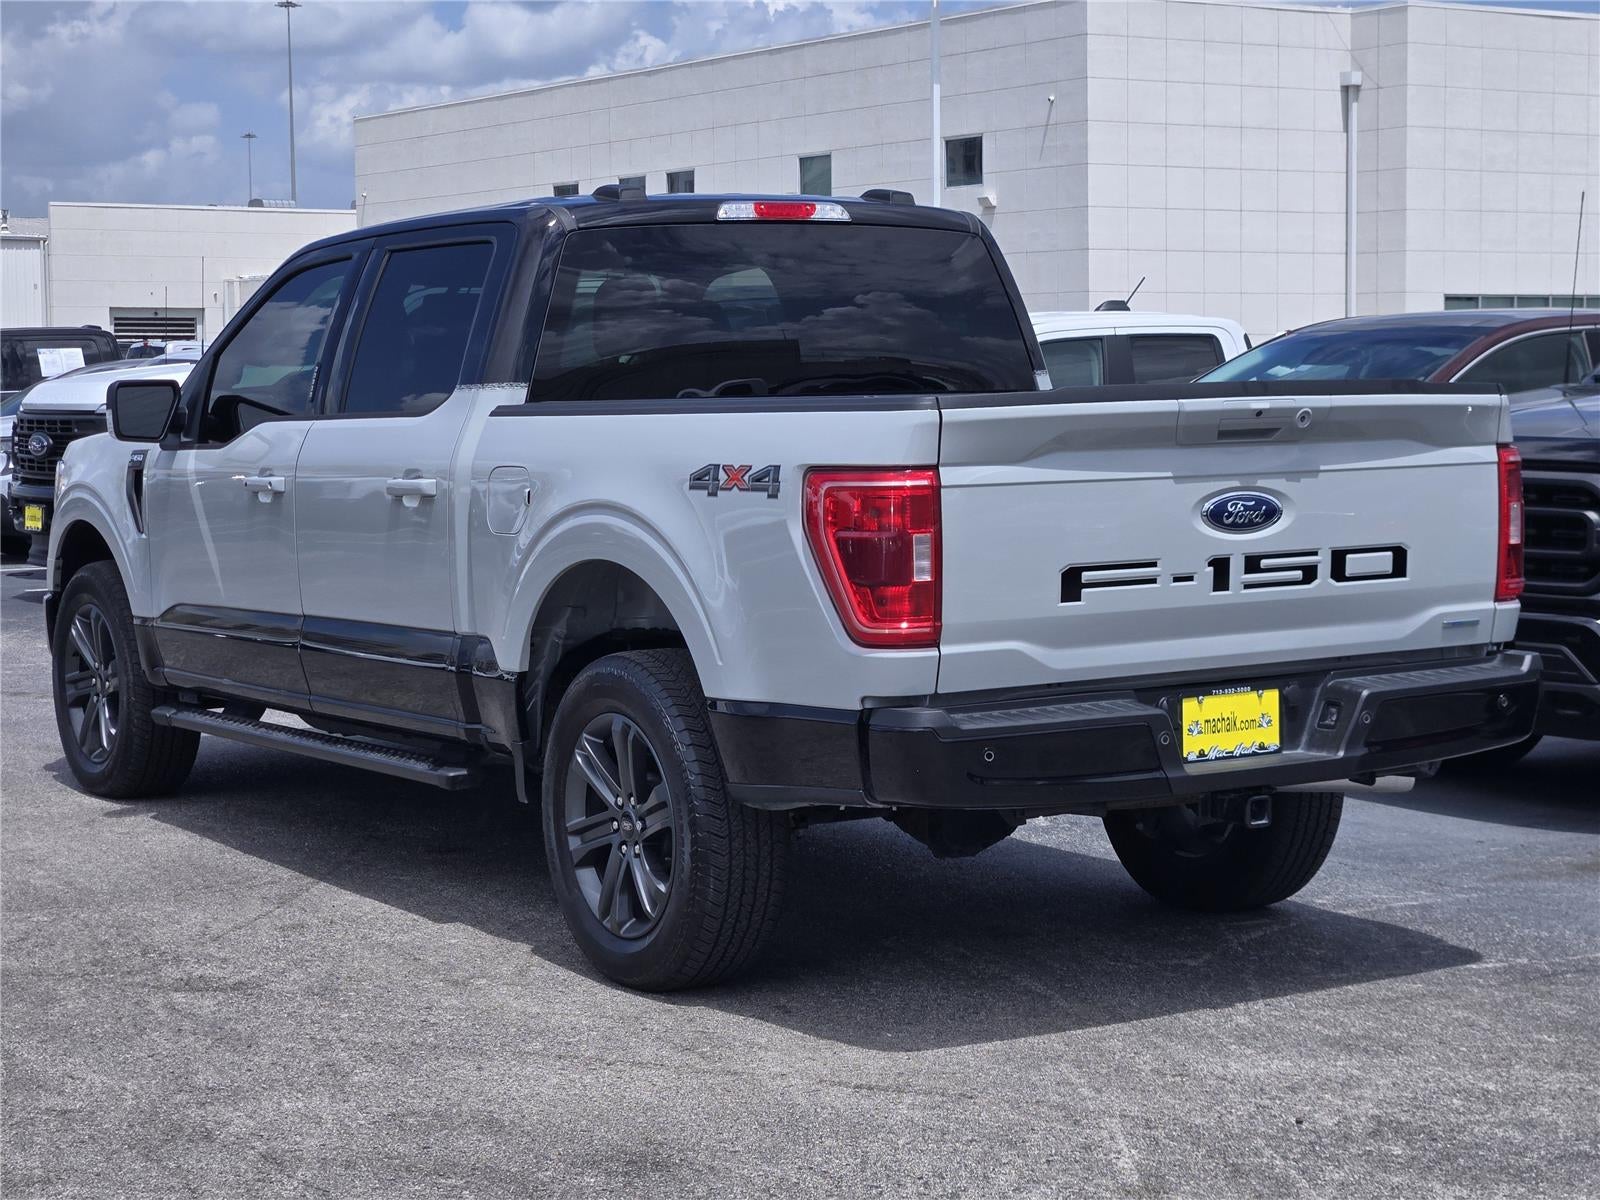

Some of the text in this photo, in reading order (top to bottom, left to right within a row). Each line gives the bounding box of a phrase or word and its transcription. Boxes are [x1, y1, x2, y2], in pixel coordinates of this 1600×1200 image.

[1223, 501, 1266, 524] Ford
[1058, 543, 1409, 606] F-150
[1204, 711, 1257, 735] machaik.com
